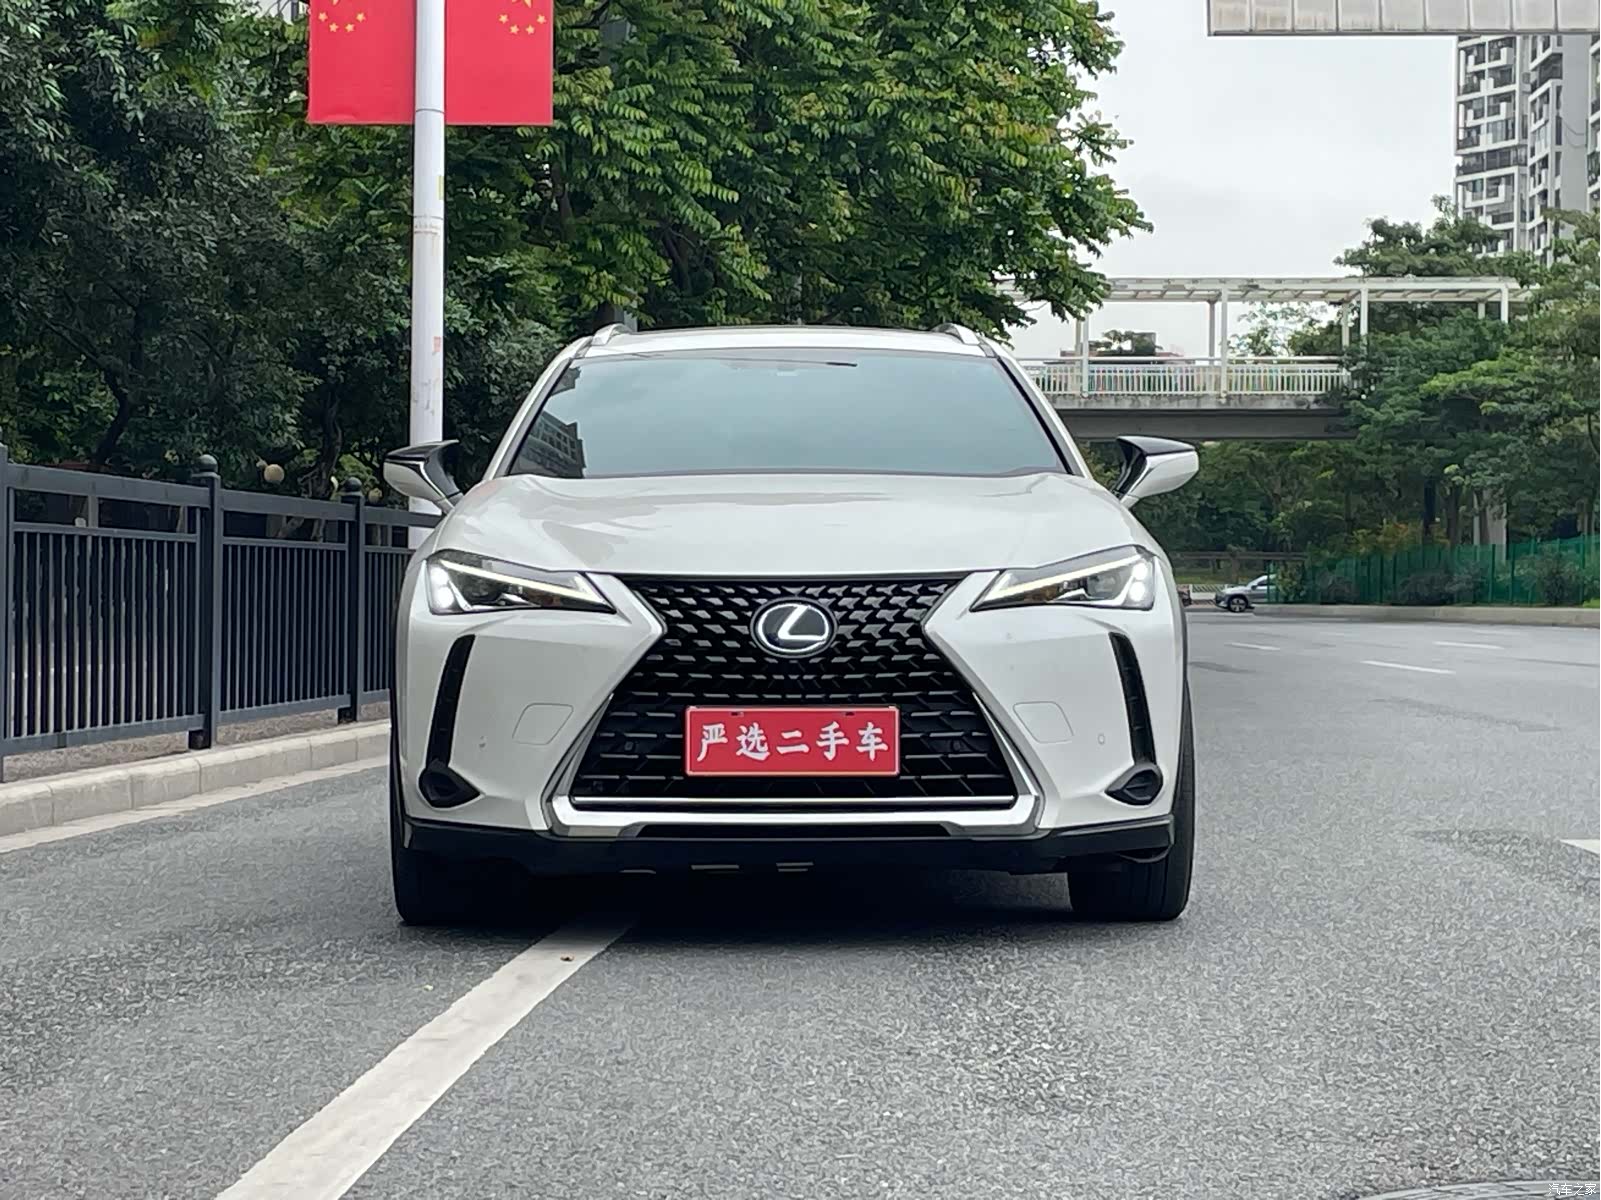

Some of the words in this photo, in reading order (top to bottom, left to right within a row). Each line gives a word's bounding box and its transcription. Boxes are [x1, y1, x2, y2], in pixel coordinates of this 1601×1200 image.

[697, 721, 889, 761] 严选二手车
